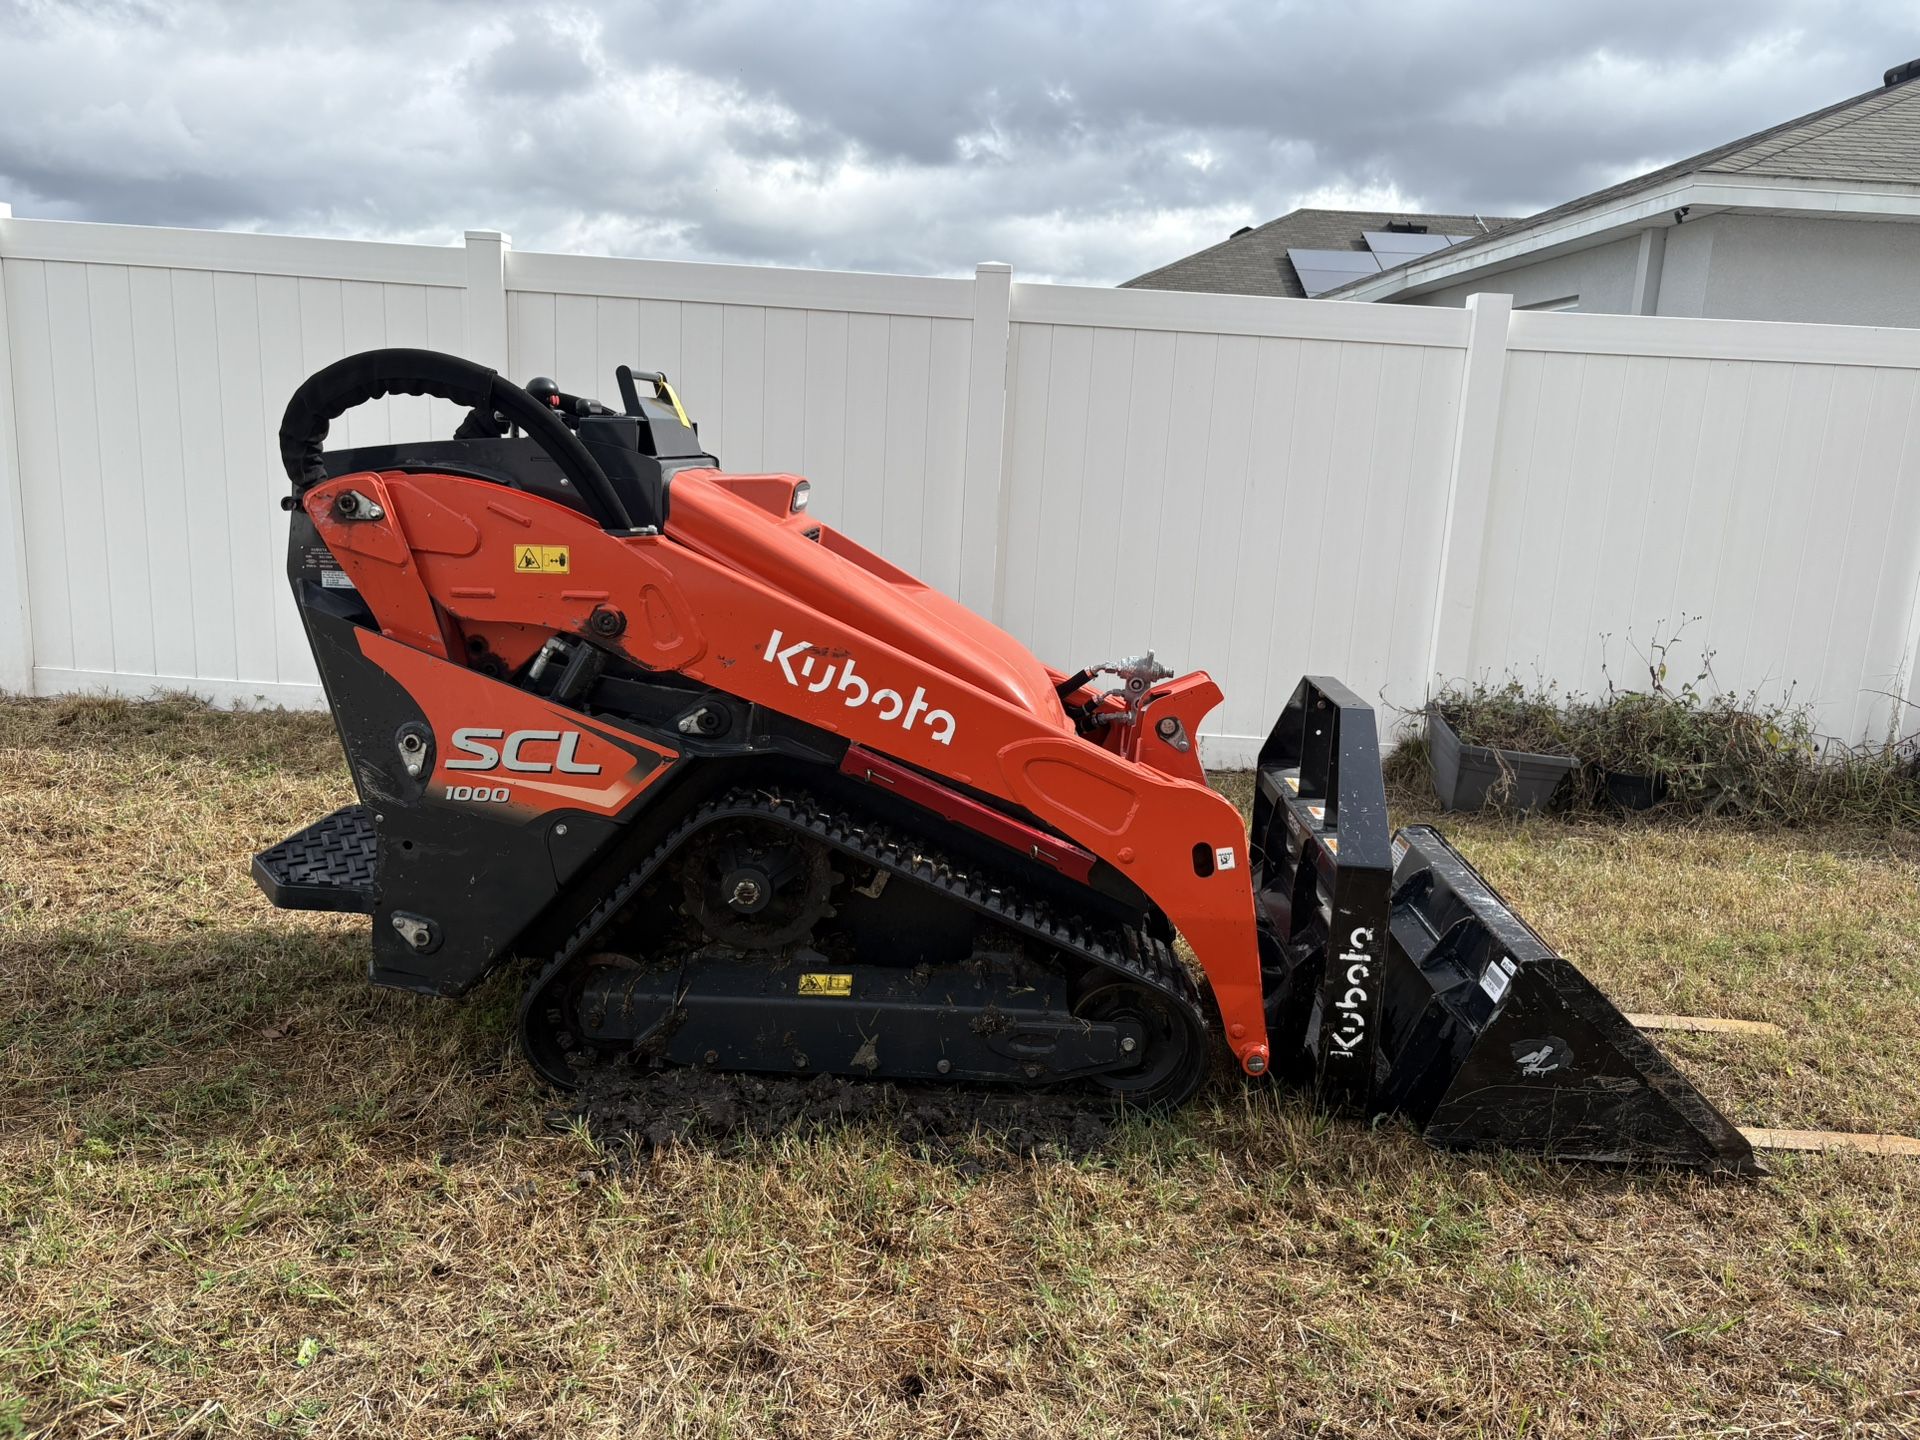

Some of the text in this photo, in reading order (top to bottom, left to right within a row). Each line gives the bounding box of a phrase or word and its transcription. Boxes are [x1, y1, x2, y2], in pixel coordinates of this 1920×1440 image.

[763, 629, 956, 746] Kubota
[444, 727, 602, 774] SCL
[445, 785, 511, 804] 1000
[1330, 926, 1374, 1059] Kubota
